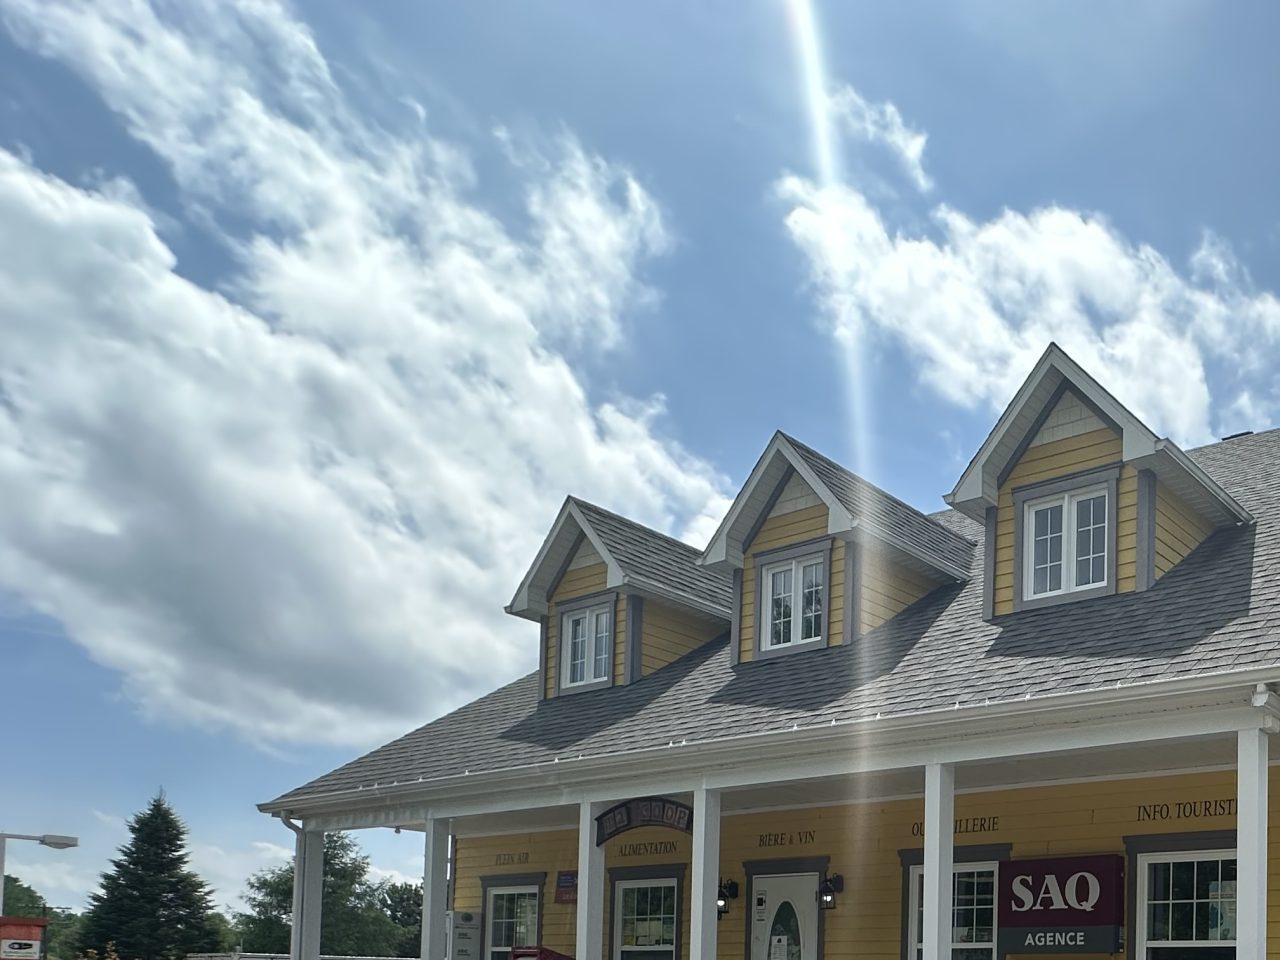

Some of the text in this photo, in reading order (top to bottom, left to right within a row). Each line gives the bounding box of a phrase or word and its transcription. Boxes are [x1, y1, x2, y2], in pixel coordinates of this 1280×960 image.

[1137, 798, 1237, 821] INFO. TOURISTI
[798, 831, 816, 844] VIN
[618, 841, 678, 857] ALIMENTATION
[1011, 872, 1100, 912] SAQ
[1024, 932, 1085, 946] AGENCE
